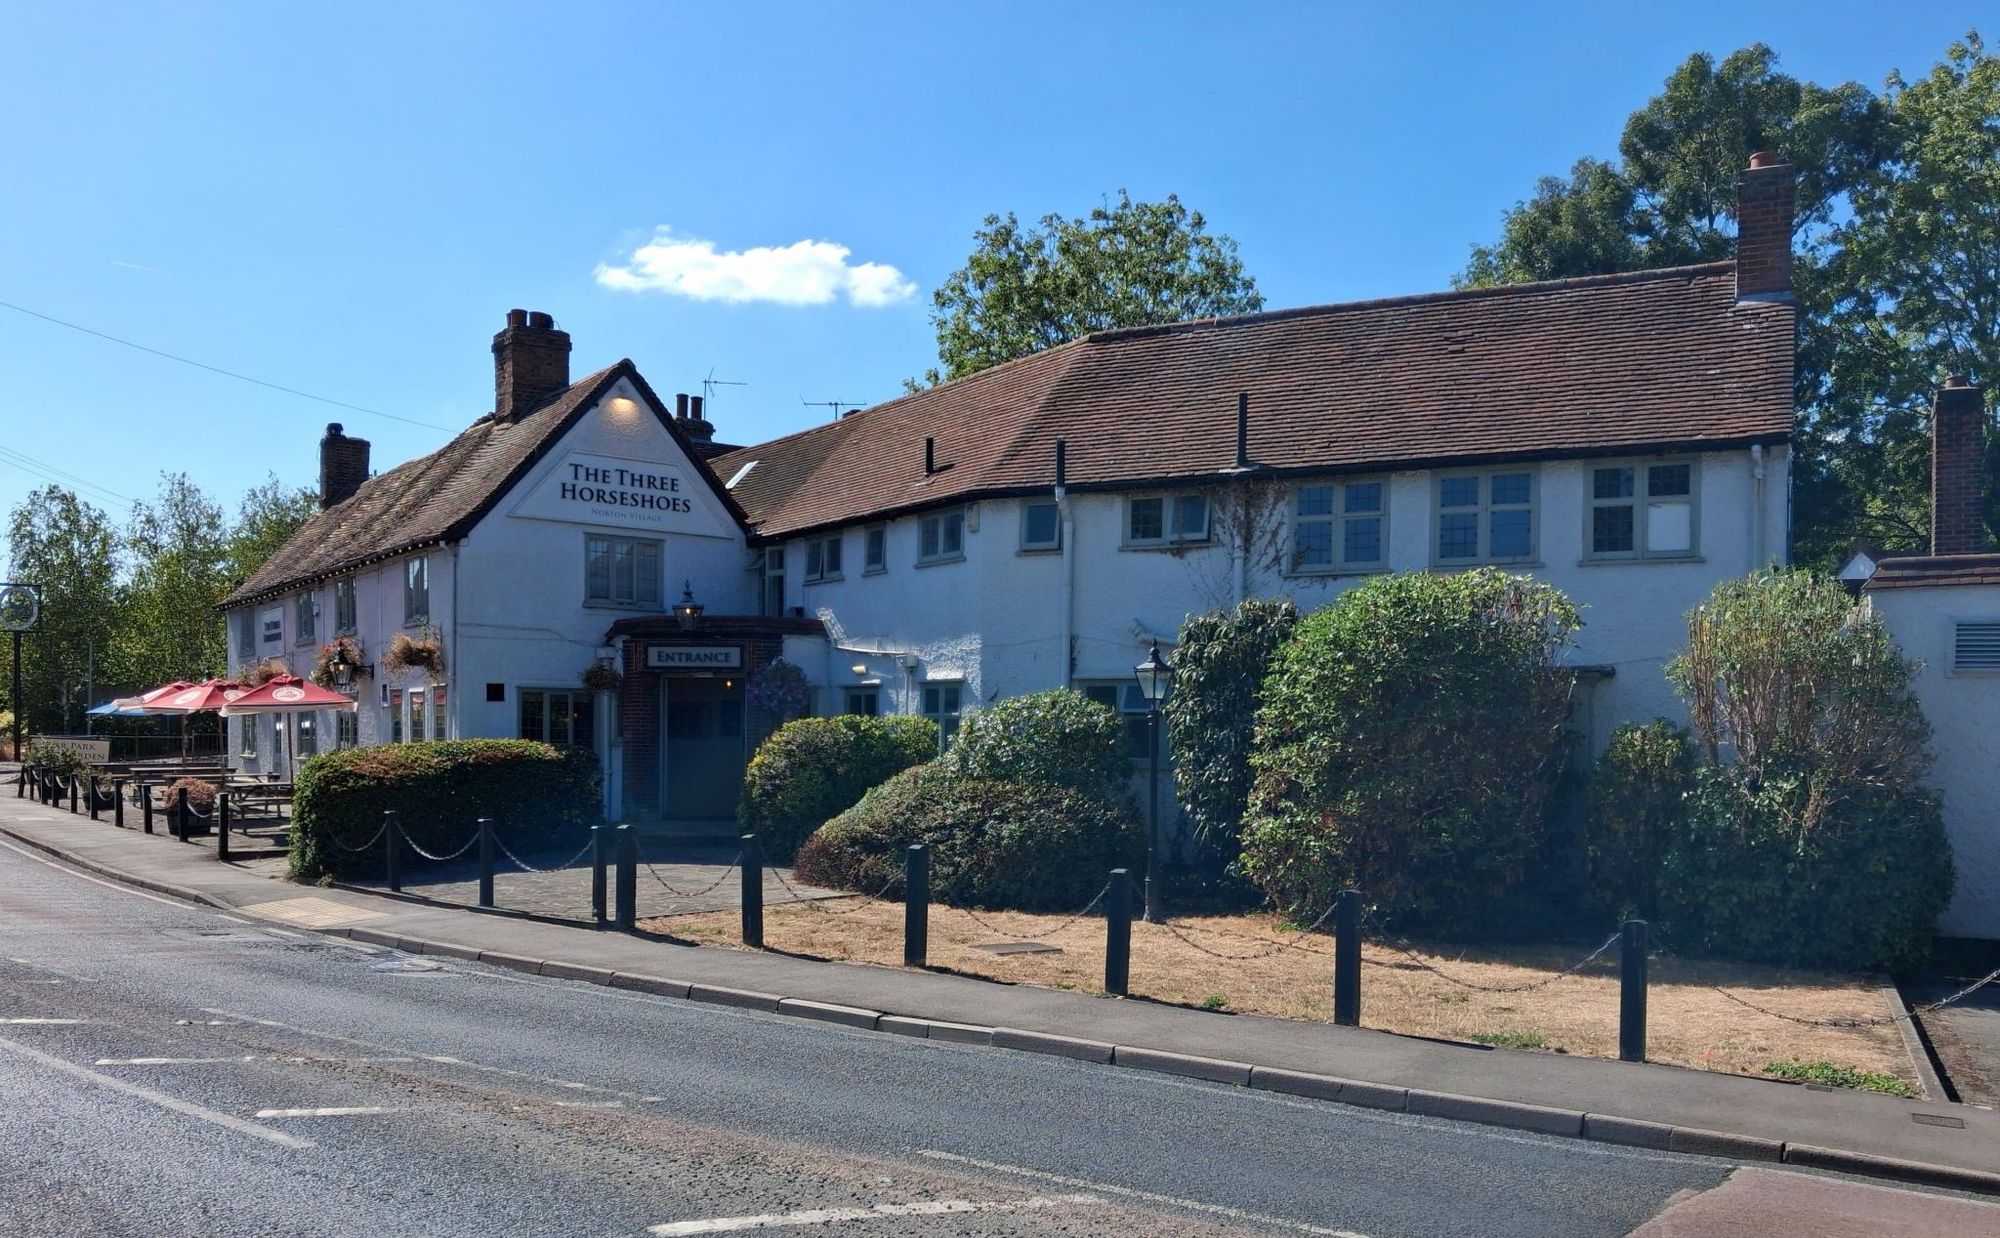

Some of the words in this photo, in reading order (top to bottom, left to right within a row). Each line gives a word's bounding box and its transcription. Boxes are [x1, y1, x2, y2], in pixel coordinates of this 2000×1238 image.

[569, 463, 611, 484] THE
[615, 468, 680, 492] THREE
[561, 482, 691, 513] HORSESHOES
[657, 650, 731, 663] ENTRANCE
